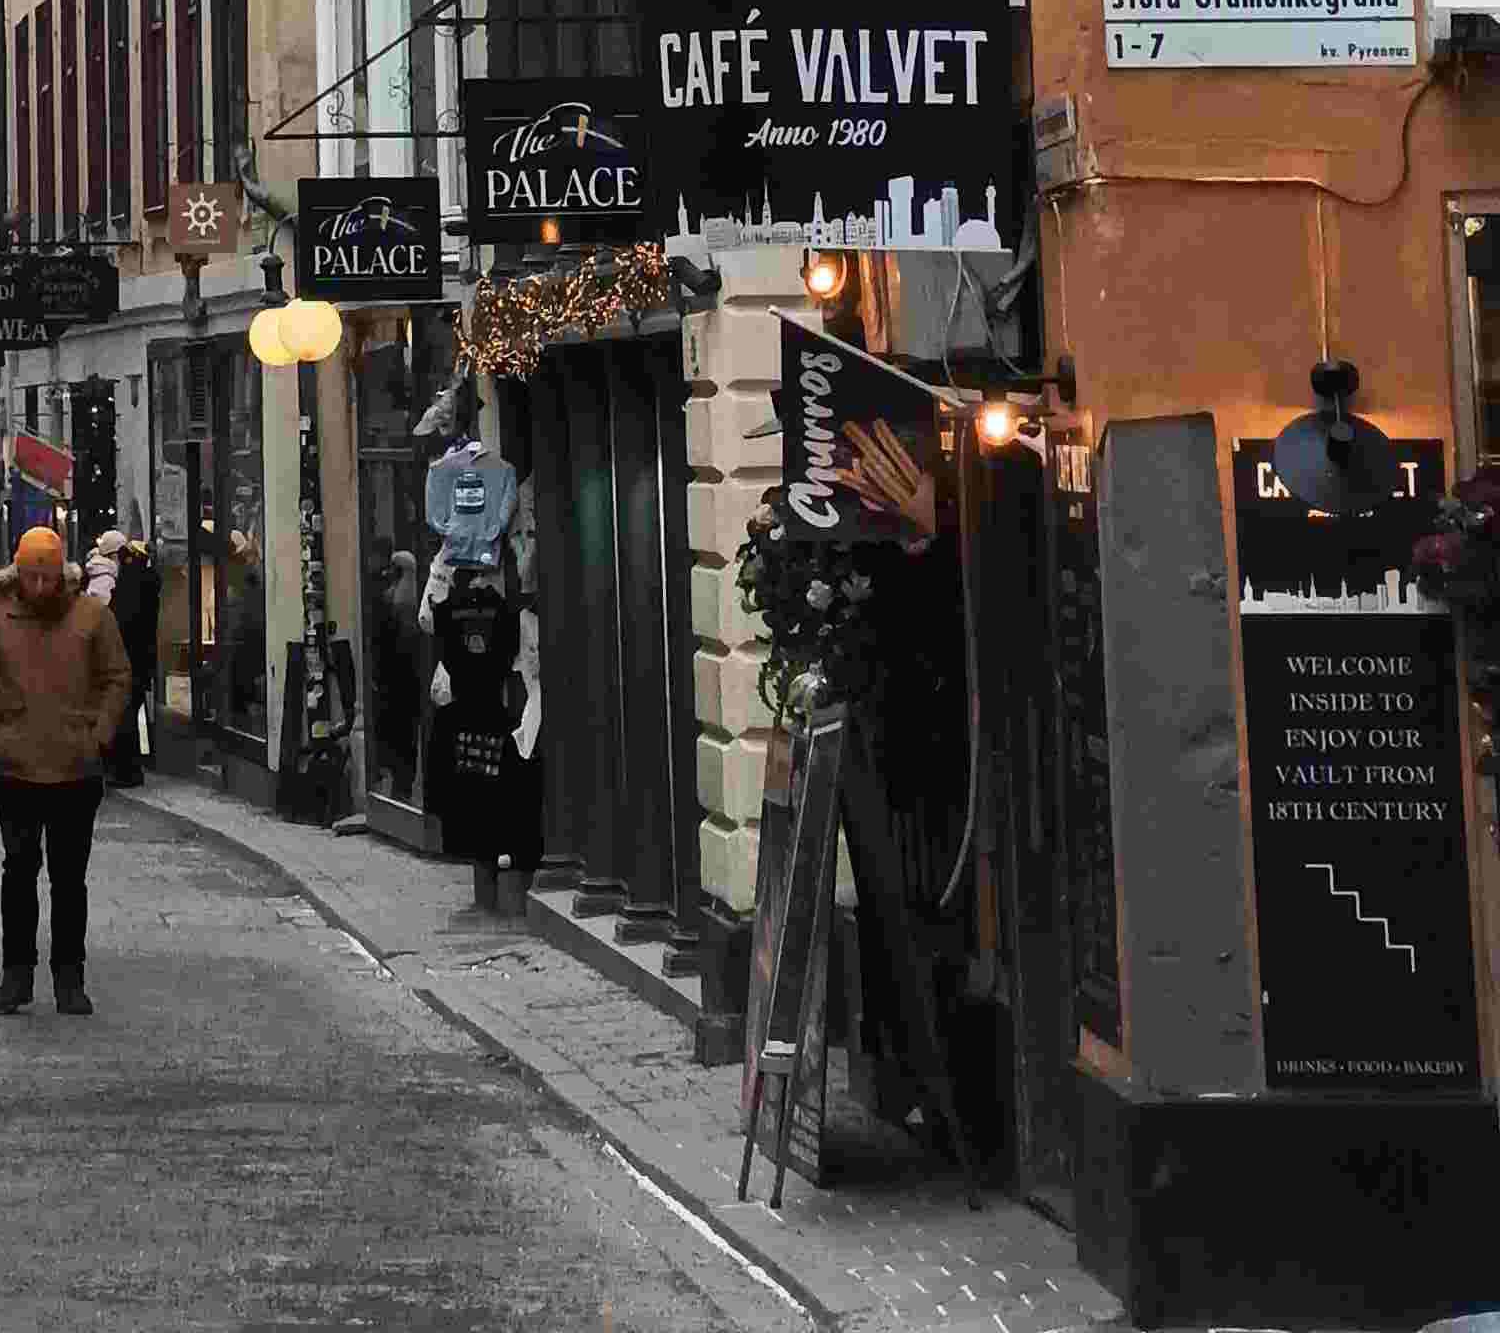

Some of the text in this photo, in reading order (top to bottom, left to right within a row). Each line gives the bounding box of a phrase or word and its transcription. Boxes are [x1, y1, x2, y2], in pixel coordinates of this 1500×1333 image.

[659, 8, 989, 108] CAFÉ VALVET
[743, 118, 888, 148] Anno 1980
[486, 166, 642, 209] PALACE
[313, 244, 428, 275] PALACE
[788, 349, 843, 528] Churros
[1256, 461, 1292, 498] CA
[1286, 656, 1413, 676] WELCOME
[1289, 692, 1414, 712] INSIDE TO
[1284, 729, 1423, 753] ENJOY OUR
[1275, 765, 1436, 784] VAULT FROM
[1268, 801, 1448, 821] 18TH CENTURY
